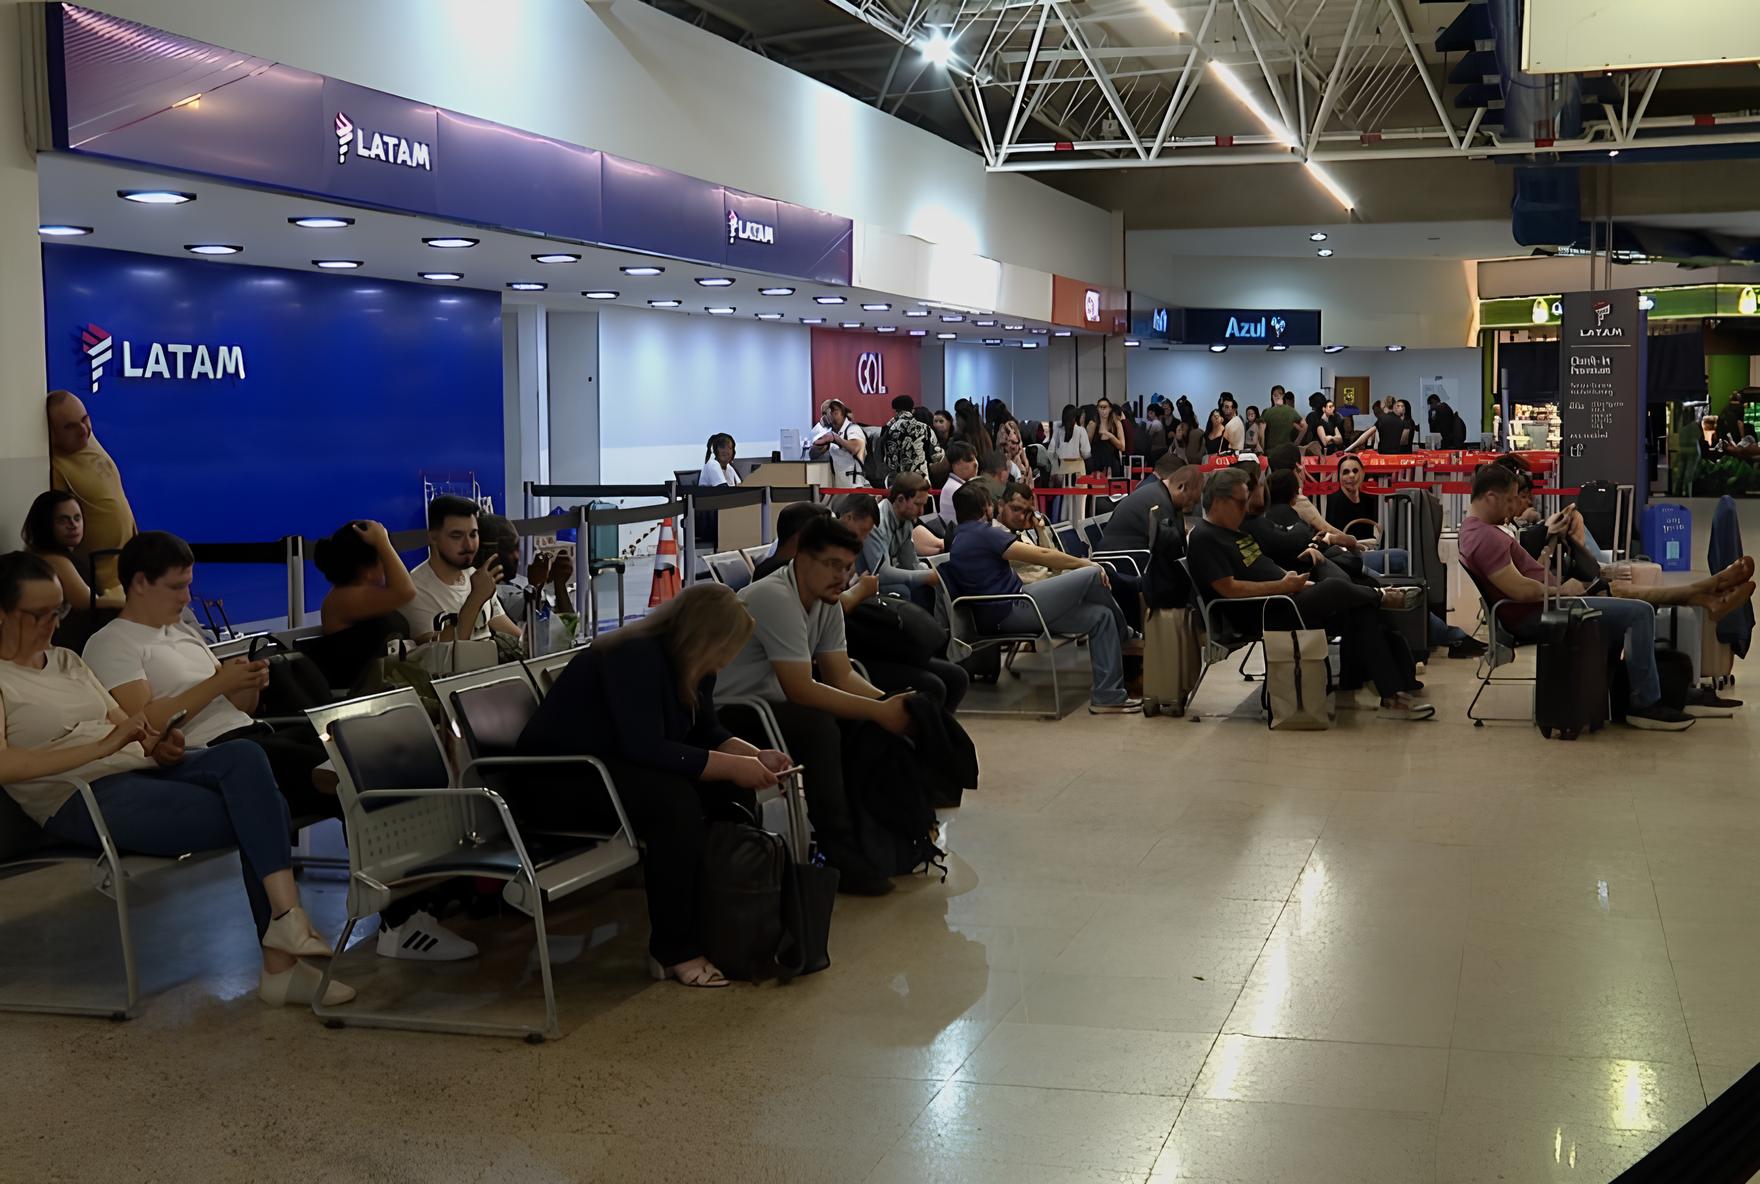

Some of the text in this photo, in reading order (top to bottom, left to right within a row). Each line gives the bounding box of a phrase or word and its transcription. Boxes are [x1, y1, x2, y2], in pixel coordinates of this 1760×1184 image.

[357, 128, 431, 171] LATAM
[1225, 316, 1266, 338] Azul
[123, 340, 246, 380] LATAM
